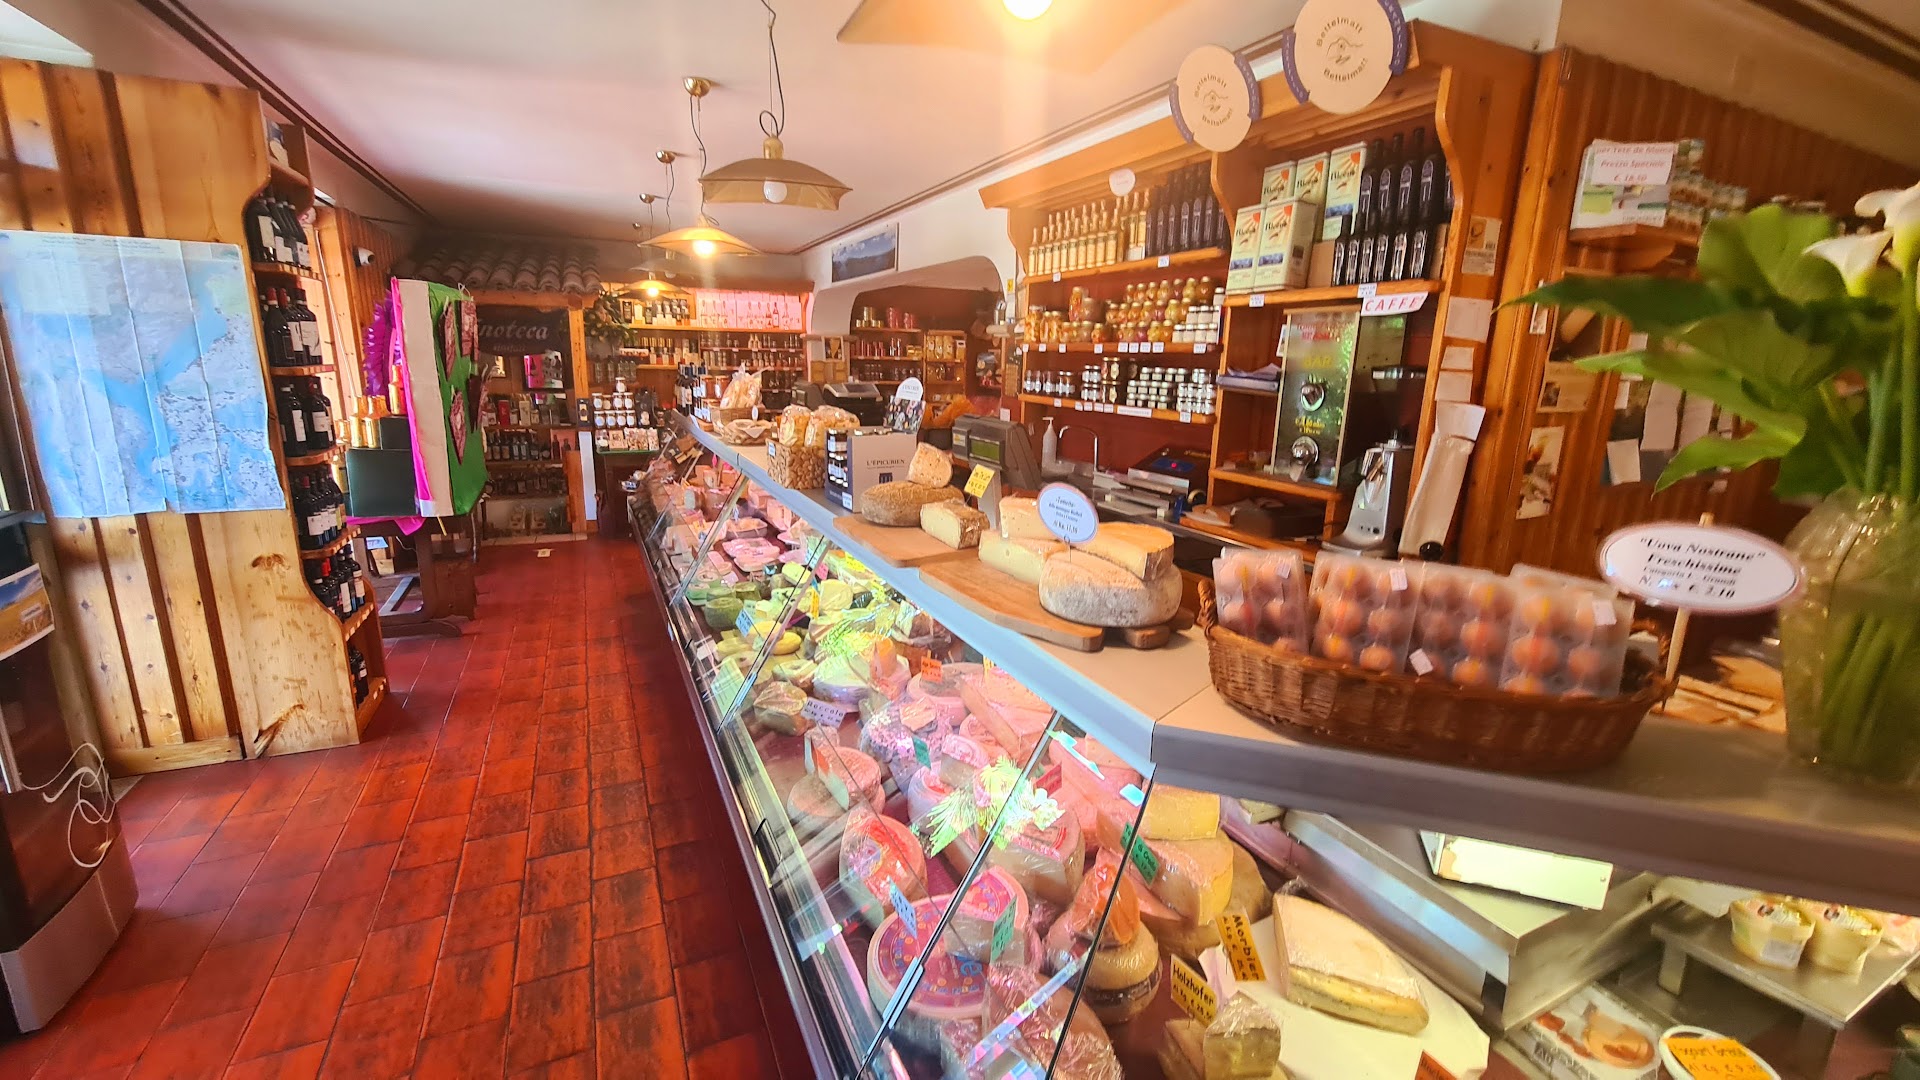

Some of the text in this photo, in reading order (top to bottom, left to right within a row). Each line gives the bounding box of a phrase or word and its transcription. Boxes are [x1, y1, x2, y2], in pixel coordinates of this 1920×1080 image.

[1316, 16, 1363, 47] Bettelmatt
[1323, 58, 1368, 81] Bettelmatt
[479, 321, 549, 340] noteca
[1648, 553, 1743, 574] Freschissime
[807, 701, 844, 718] Roccolo
[1232, 914, 1260, 981] Morbier
[1172, 964, 1214, 1007] Holzhofer
